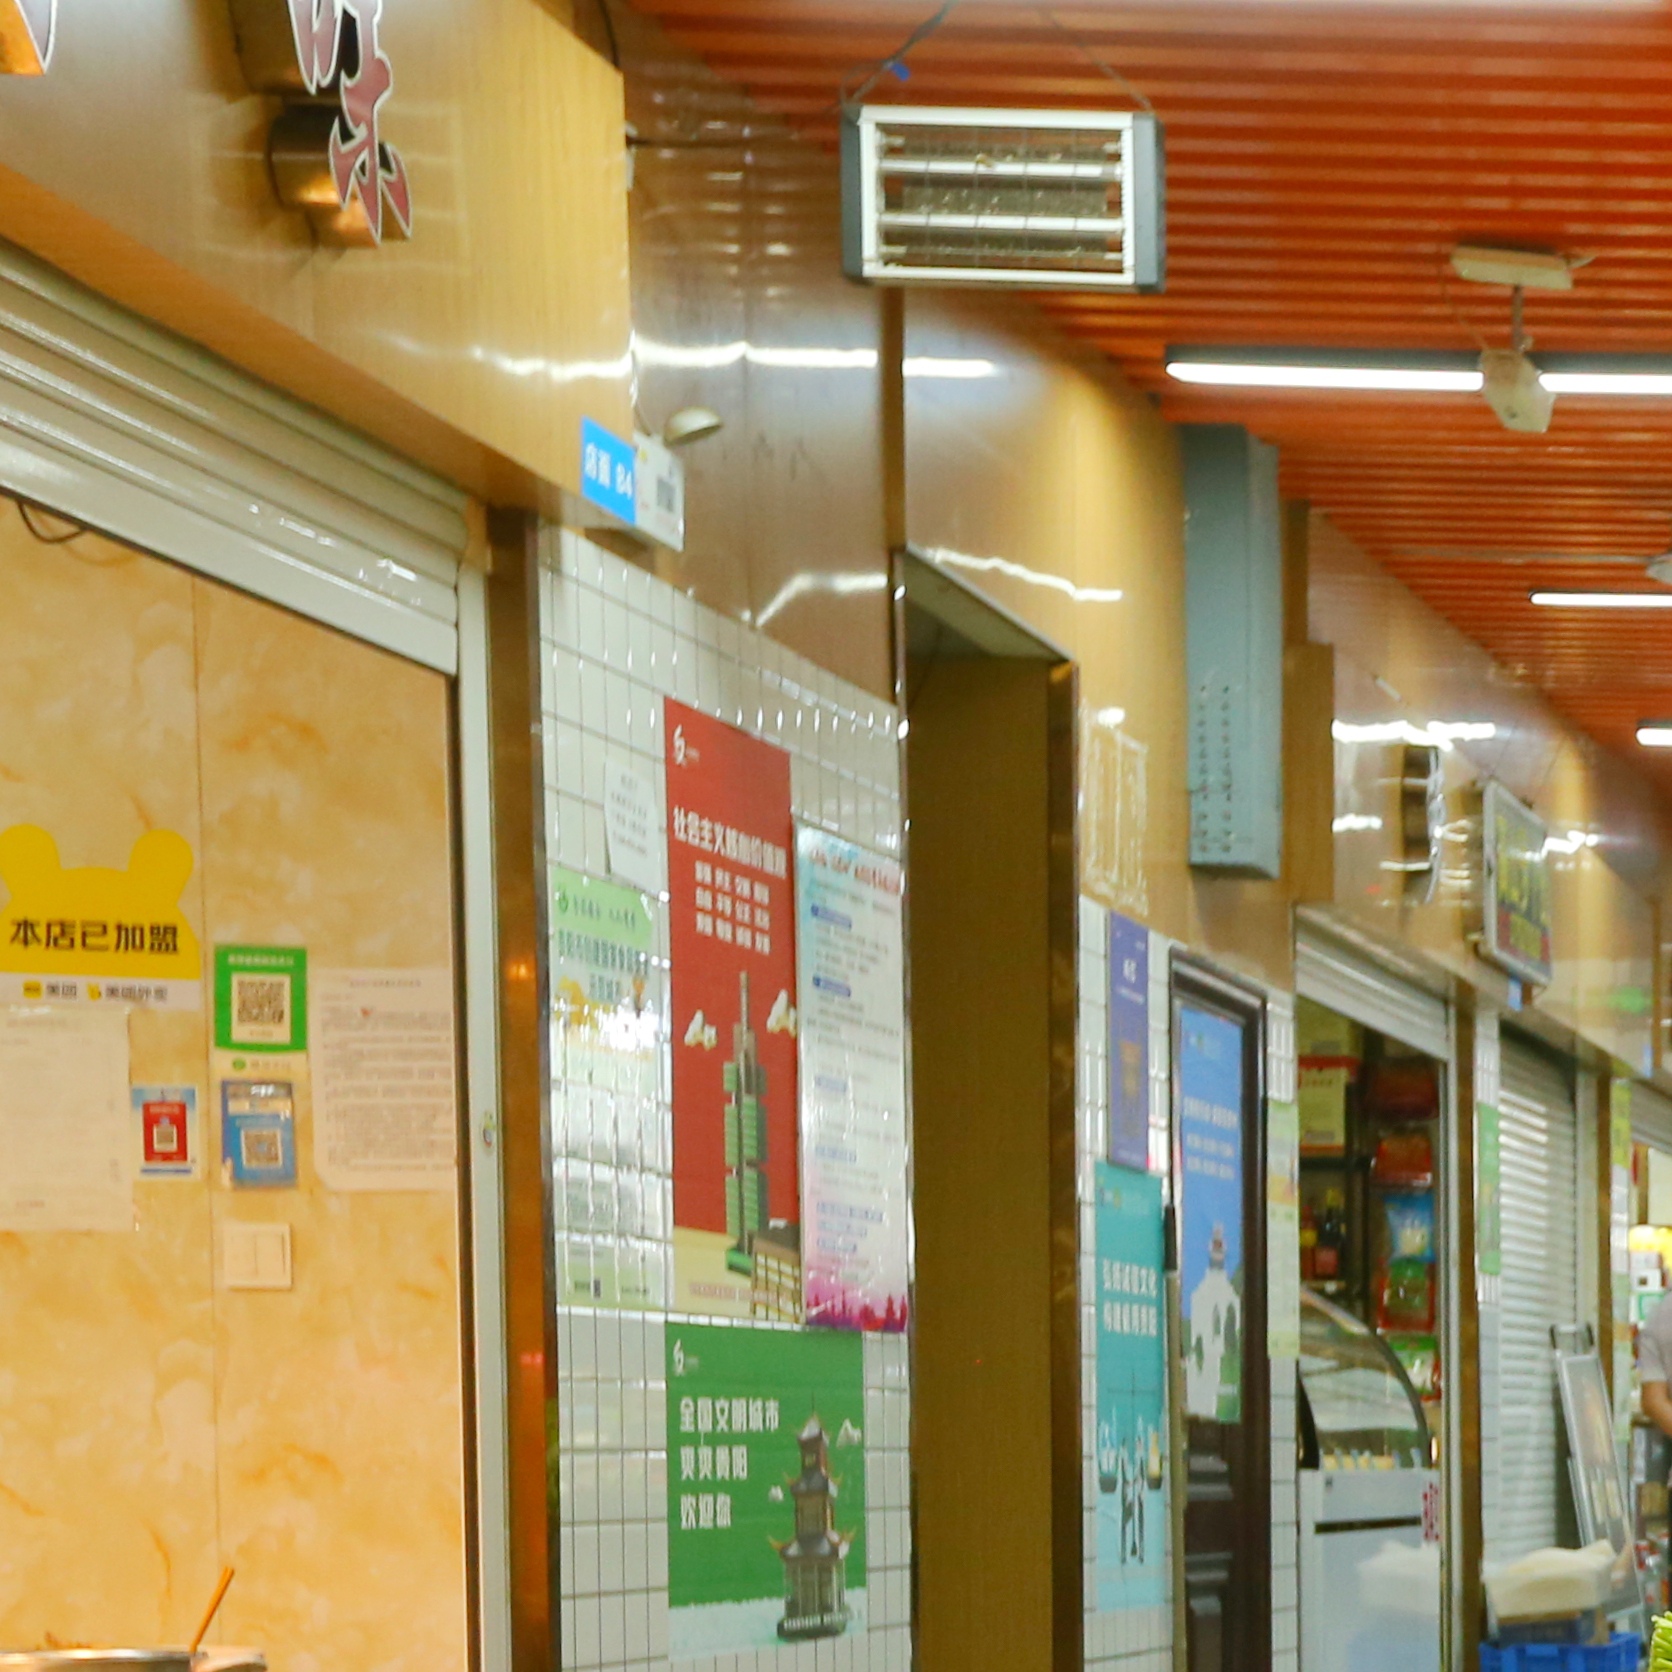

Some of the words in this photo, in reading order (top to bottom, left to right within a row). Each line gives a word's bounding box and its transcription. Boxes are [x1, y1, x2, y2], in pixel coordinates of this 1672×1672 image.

[9, 917, 180, 954] 本店已加盟
[679, 1396, 779, 1433] 全国文明城市
[680, 1445, 748, 1481] 爽爽贵阳
